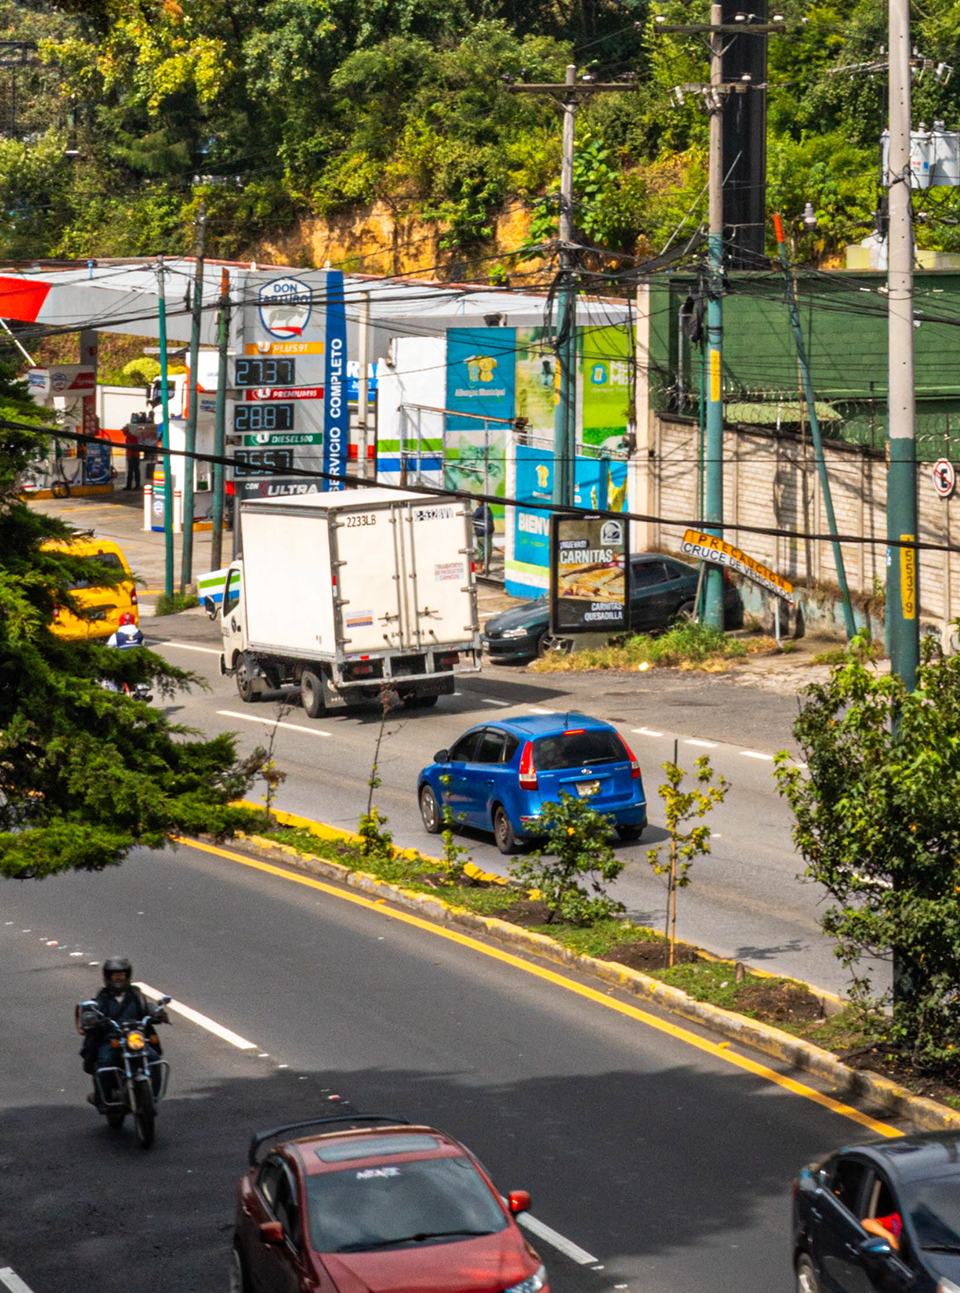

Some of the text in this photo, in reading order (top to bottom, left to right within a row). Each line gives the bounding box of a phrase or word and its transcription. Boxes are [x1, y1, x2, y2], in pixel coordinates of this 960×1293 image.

[273, 283, 298, 293] DON
[330, 338, 343, 418] COMPLETO
[267, 483, 318, 497] ULTRA
[346, 514, 377, 528] 2233LB
[559, 549, 614, 564] CARNITAS
[683, 541, 726, 563] CRUCE
[728, 557, 742, 571] DE
[591, 603, 623, 611] CARNITAS
[584, 611, 623, 621] QUESADILLA
